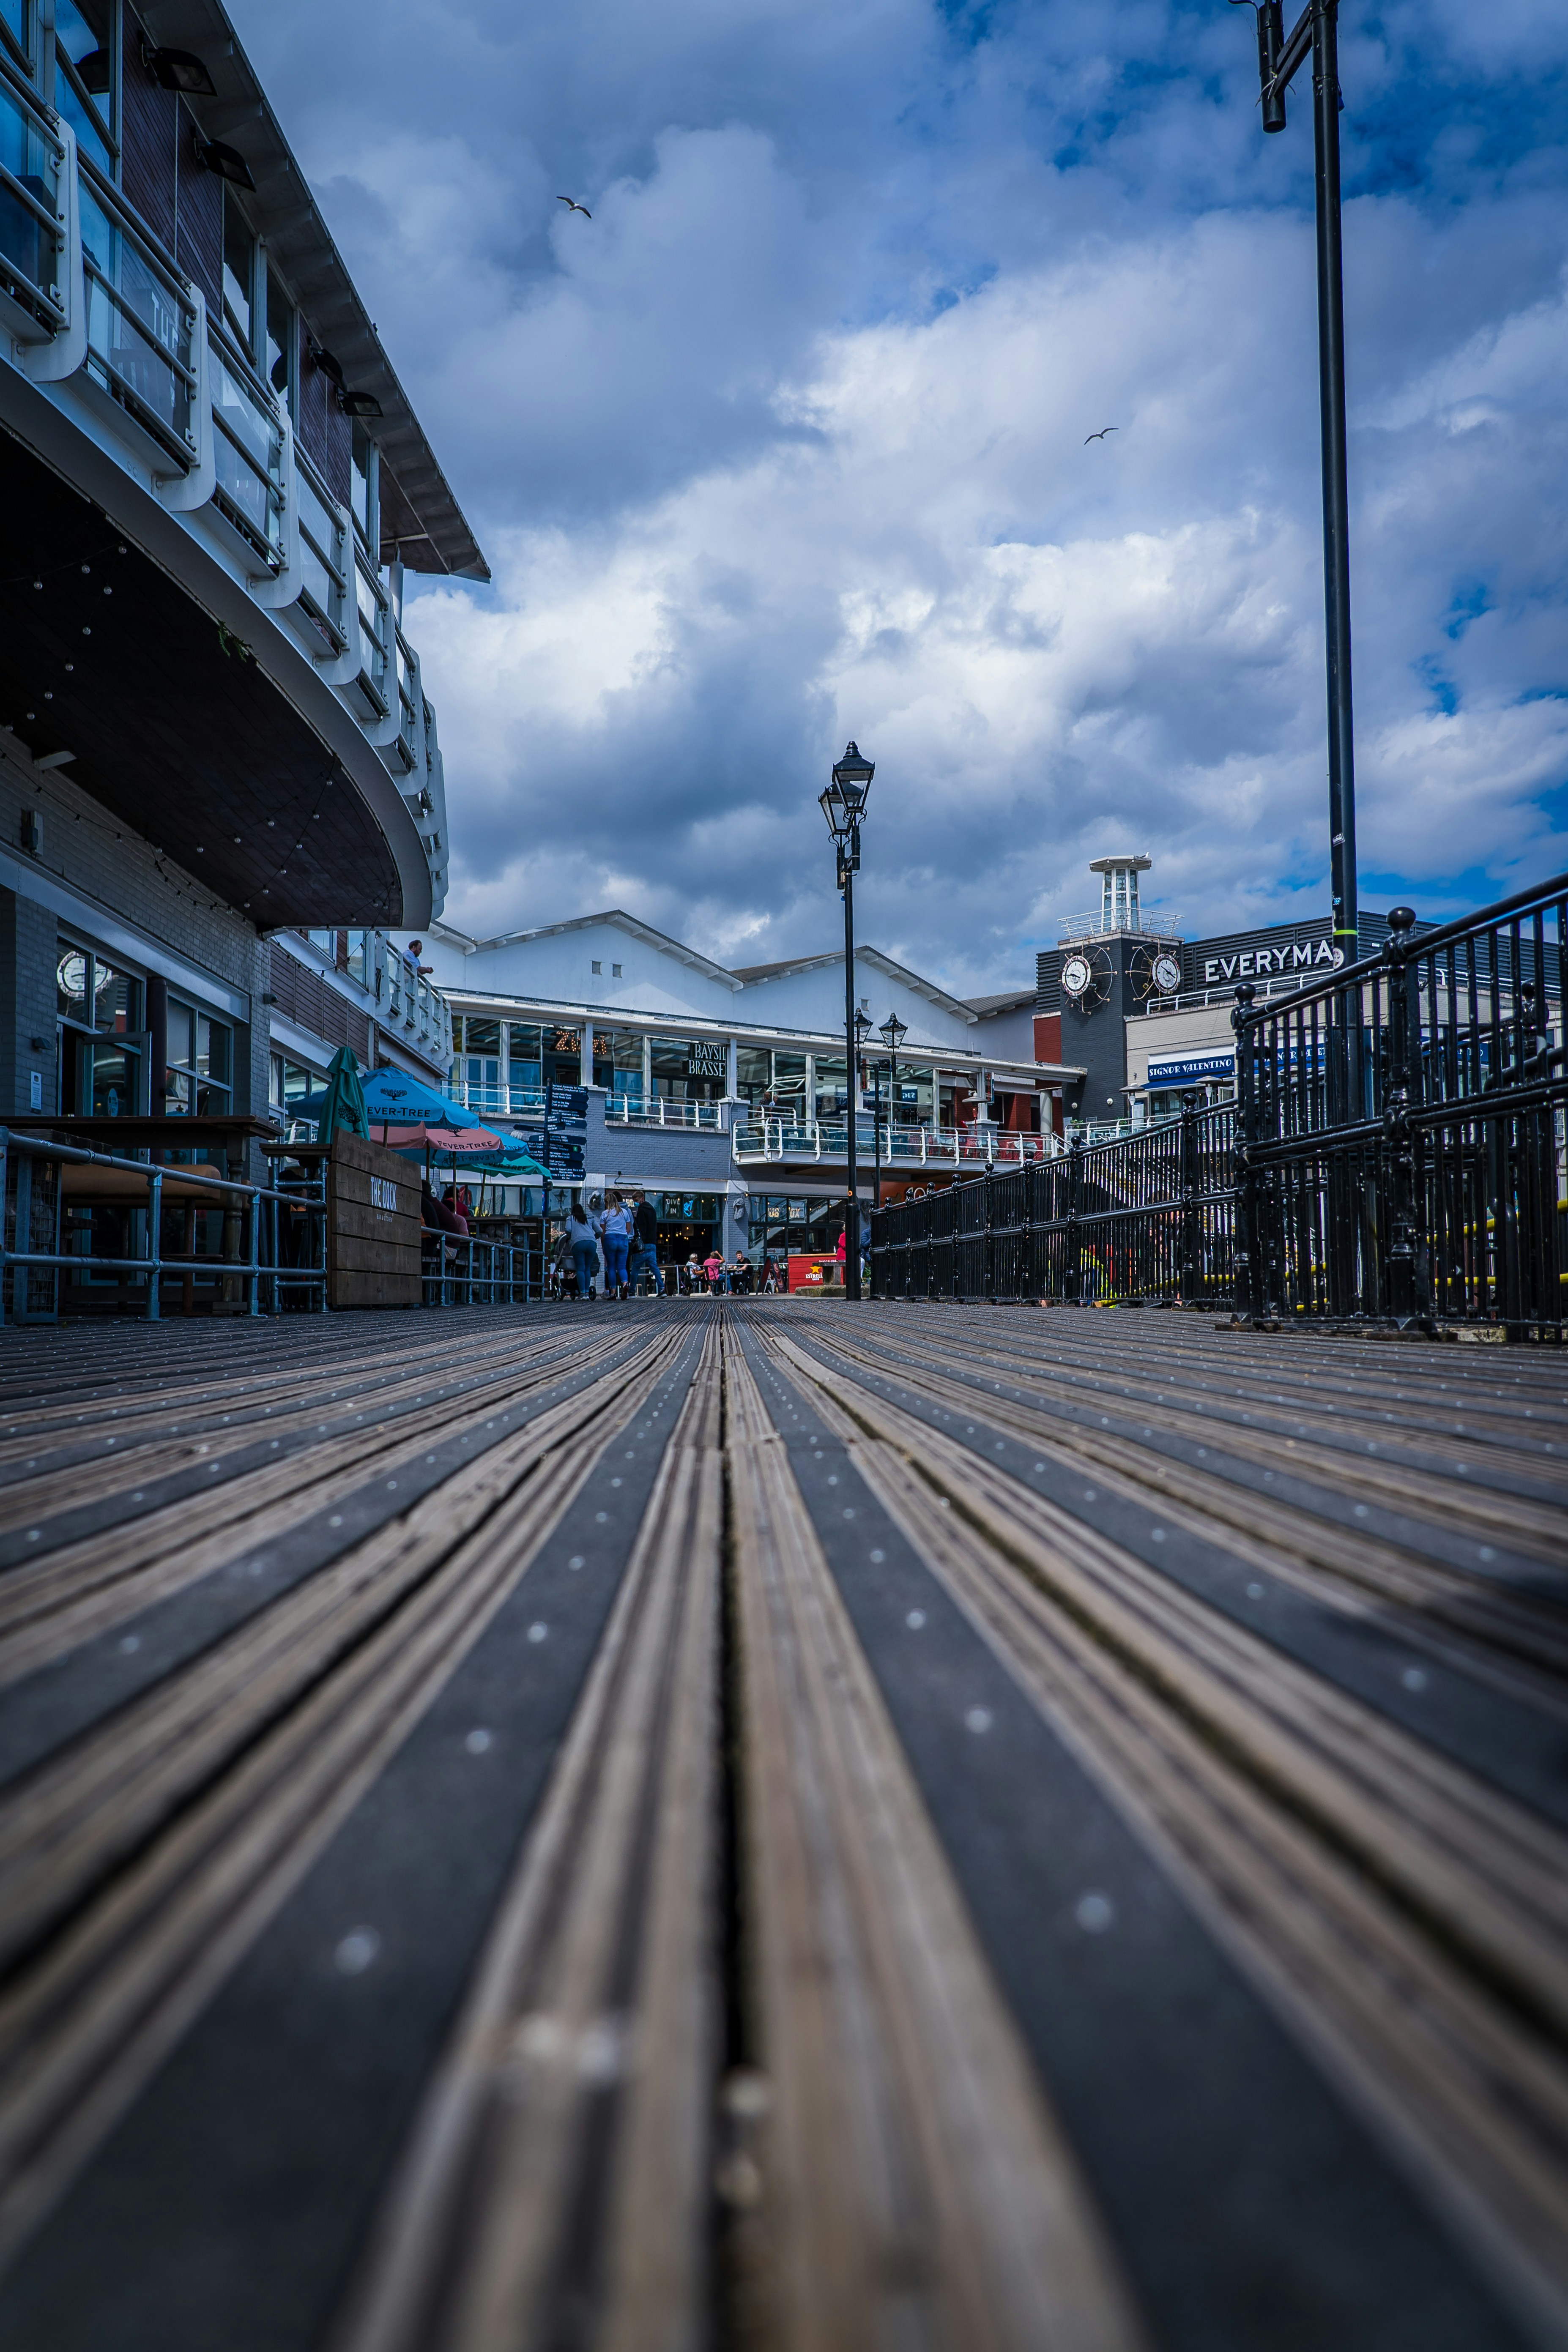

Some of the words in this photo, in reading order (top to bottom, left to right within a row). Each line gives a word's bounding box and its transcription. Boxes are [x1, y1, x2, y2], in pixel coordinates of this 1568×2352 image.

[1205, 940, 1334, 982] EVERYMA
[555, 1031, 607, 1055] Zizi
[1149, 1066, 1180, 1076] SIGNOR
[1182, 1059, 1232, 1073] VALENTINO
[366, 1106, 431, 1117] EVER-TREE
[437, 1140, 493, 1150] FEVER-TREE
[371, 1176, 381, 1207] THE
[383, 1180, 397, 1211] DOCK
